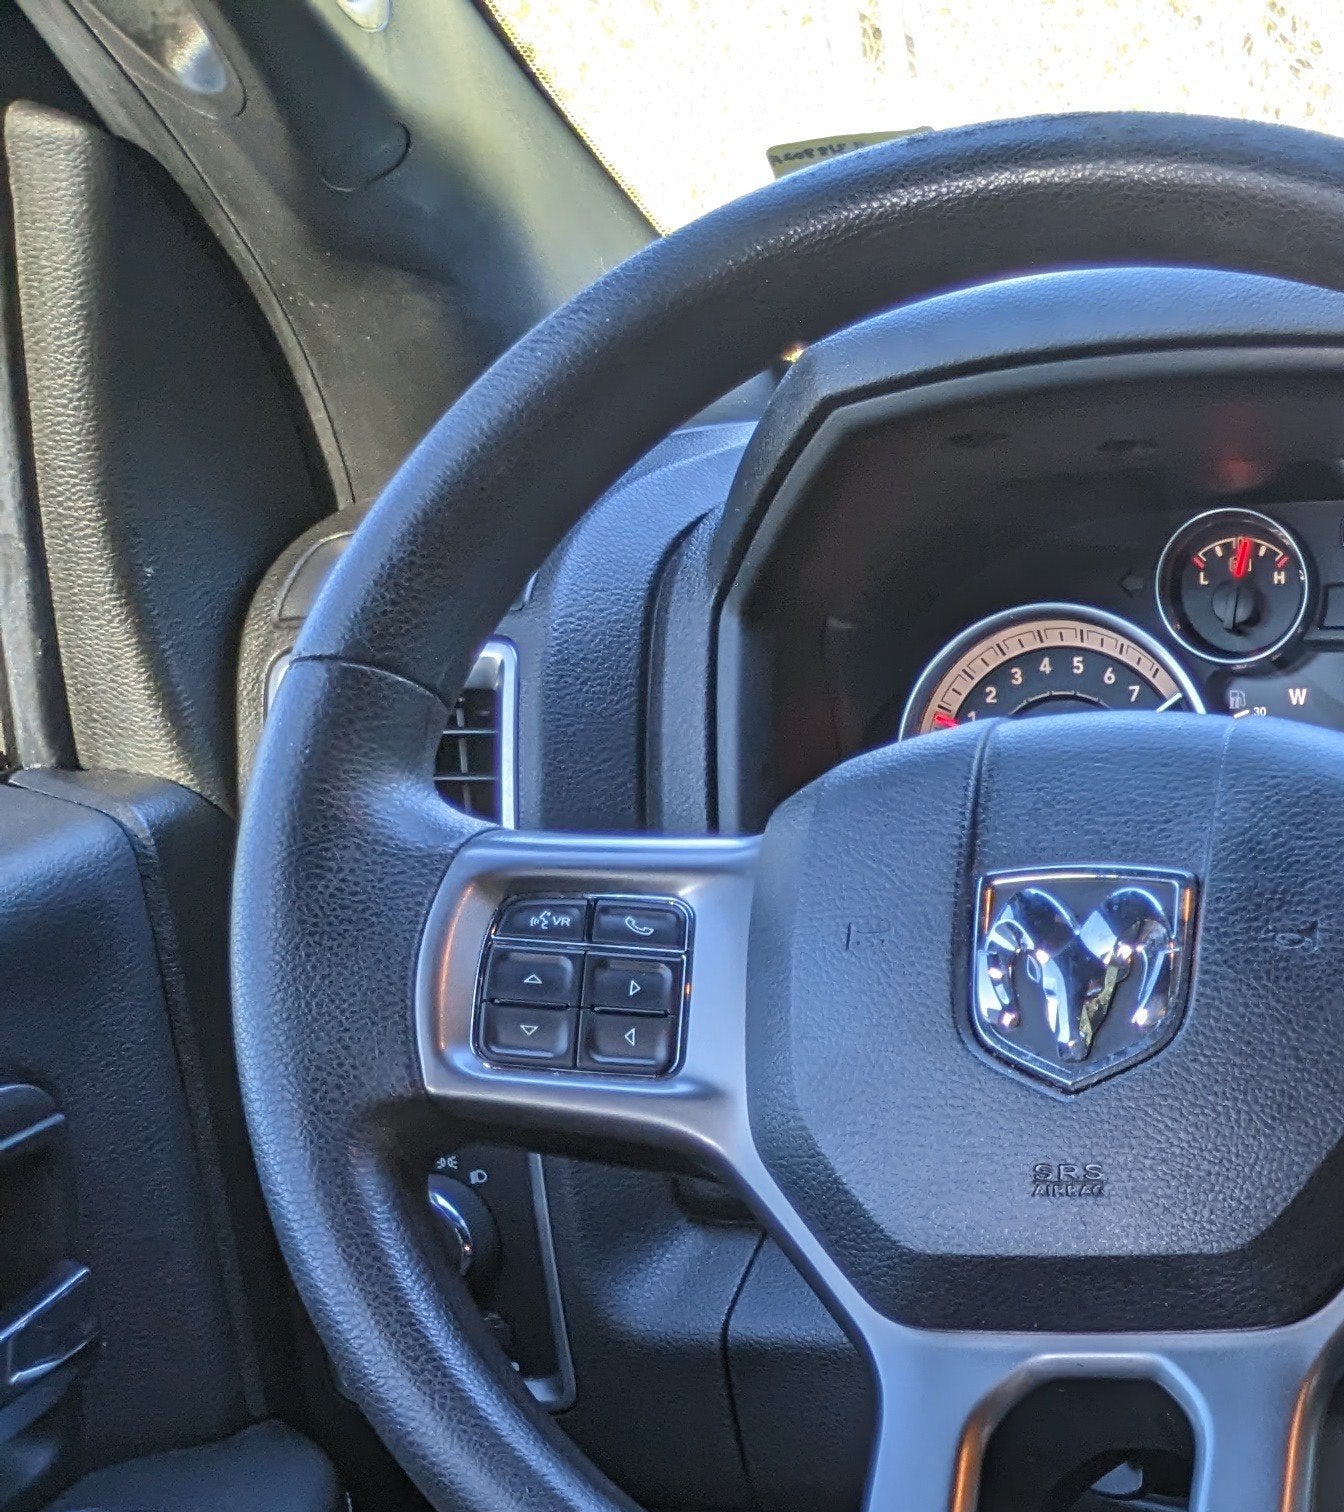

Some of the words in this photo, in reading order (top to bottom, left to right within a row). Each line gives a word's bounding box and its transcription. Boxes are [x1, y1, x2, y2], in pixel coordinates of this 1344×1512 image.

[1273, 571, 1286, 585] H
[1039, 657, 1052, 674] 4
[1072, 656, 1084, 674] 5
[1011, 669, 1023, 685] 3
[1103, 668, 1116, 684] 6
[985, 686, 997, 703] 2
[1128, 686, 1141, 702] 7
[1289, 687, 1307, 705] W
[1253, 707, 1267, 717] 30
[553, 916, 571, 928] VR
[1032, 1163, 1105, 1181] SRS
